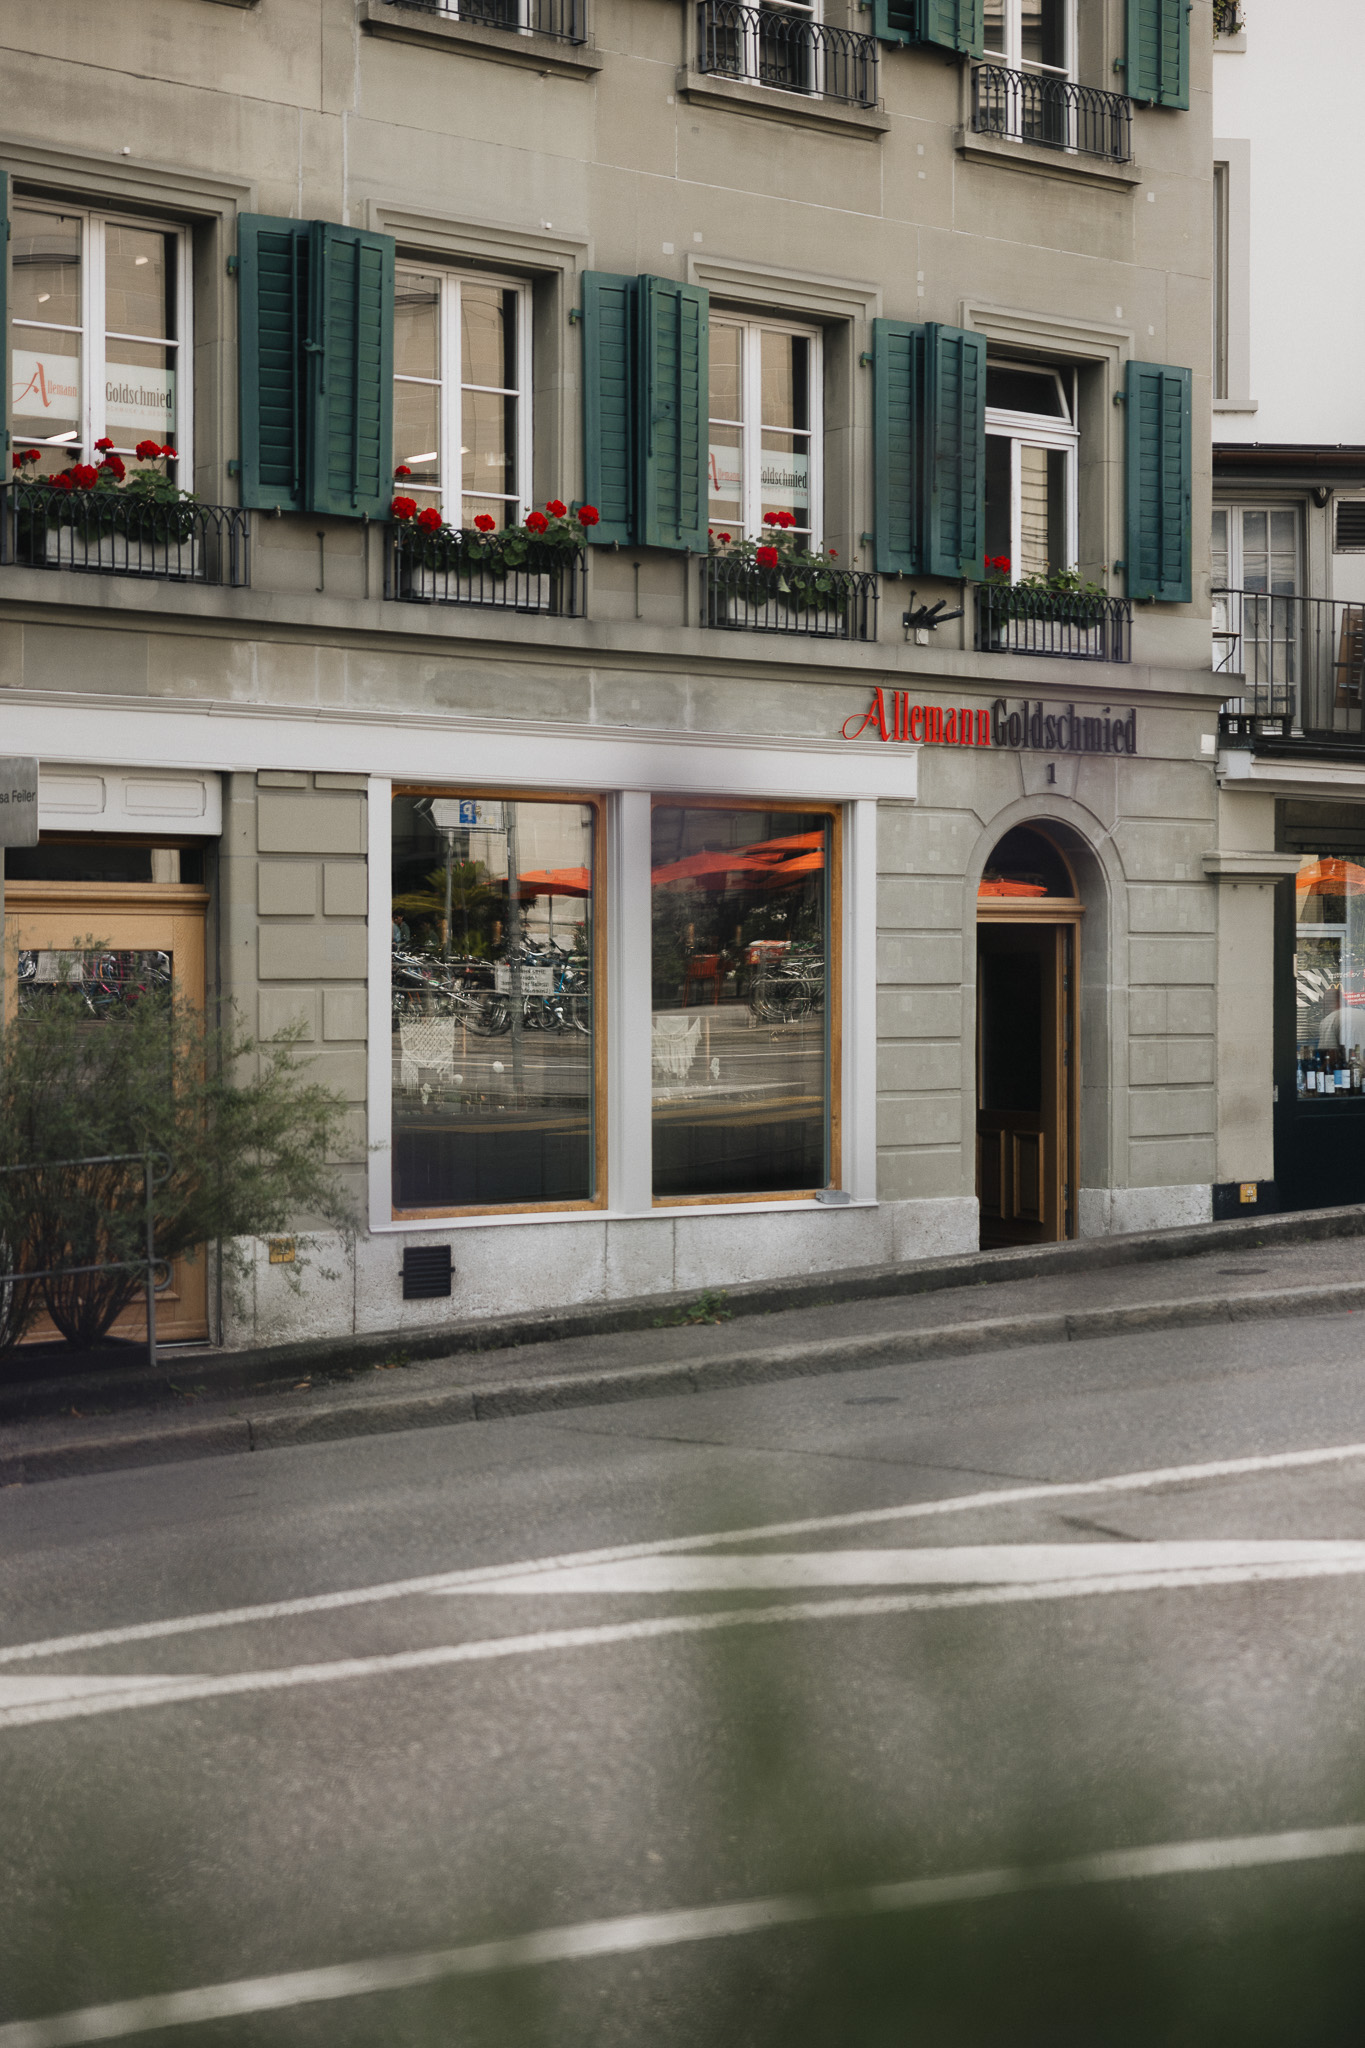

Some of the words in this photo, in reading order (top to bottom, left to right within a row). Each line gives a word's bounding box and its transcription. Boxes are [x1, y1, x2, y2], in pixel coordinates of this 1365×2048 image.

[12, 361, 77, 408] Allemann
[105, 381, 172, 409] Goldschmied
[760, 466, 807, 489] oldschmied
[839, 686, 991, 746] Allemann
[992, 698, 1137, 754] Goldschmied
[1047, 762, 1057, 784] 1
[12, 789, 36, 803] Feiler
